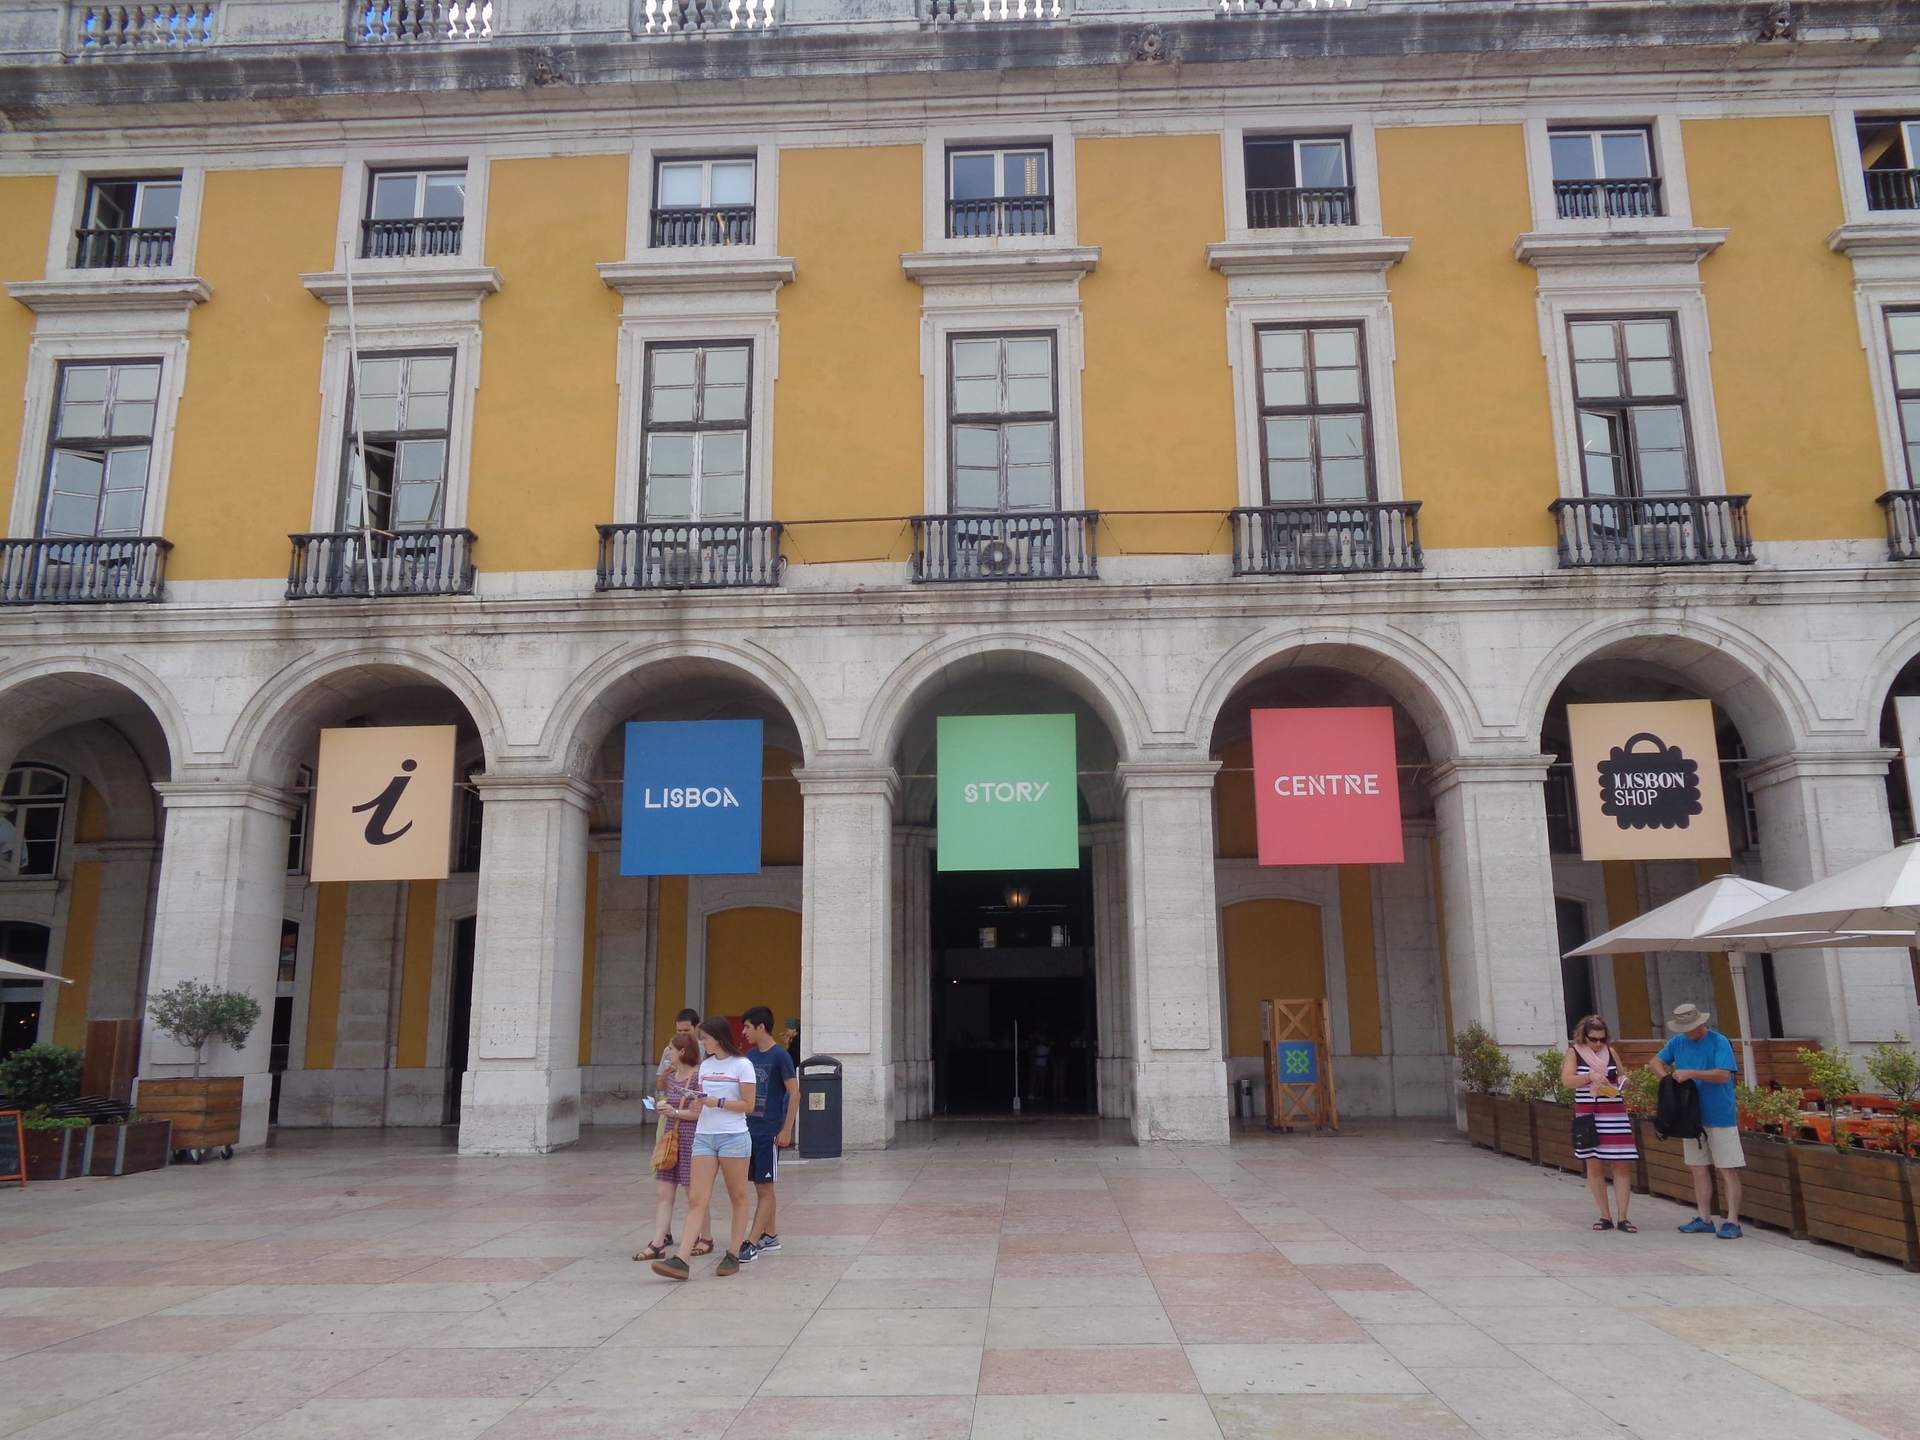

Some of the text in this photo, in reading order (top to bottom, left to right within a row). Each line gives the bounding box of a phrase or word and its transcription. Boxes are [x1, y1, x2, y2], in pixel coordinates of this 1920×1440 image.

[1273, 773, 1380, 797] CENTRE
[1613, 772, 1685, 789] LISBON
[644, 787, 740, 809] LISBOA
[963, 781, 1050, 804] STORY
[1614, 789, 1659, 806] SHOP
